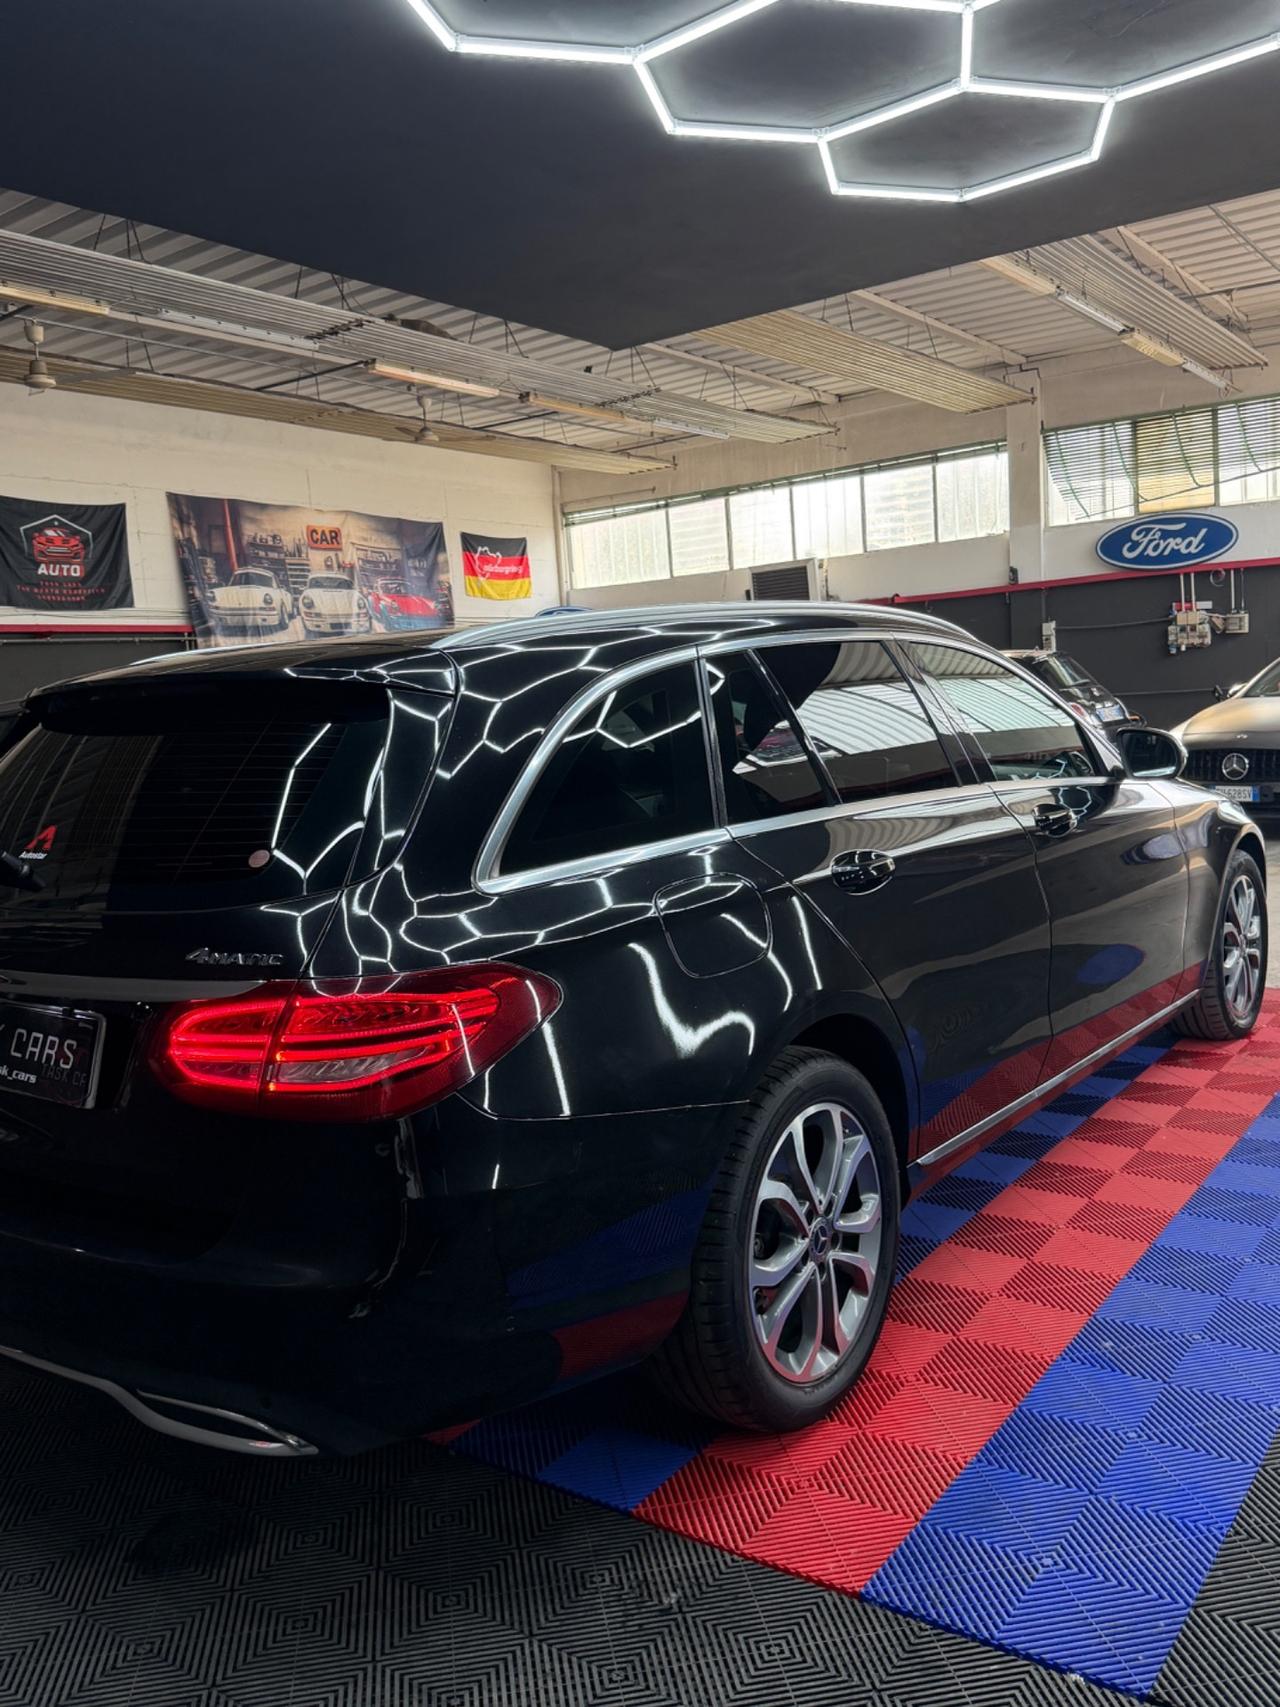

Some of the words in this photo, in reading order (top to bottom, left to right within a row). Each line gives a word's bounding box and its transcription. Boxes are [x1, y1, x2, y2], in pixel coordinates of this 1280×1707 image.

[310, 528, 340, 545] CAR
[1121, 522, 1208, 559] Ford
[37, 563, 81, 577] AUTO
[184, 946, 283, 966] 4MATIC
[10, 1028, 77, 1069] CARS
